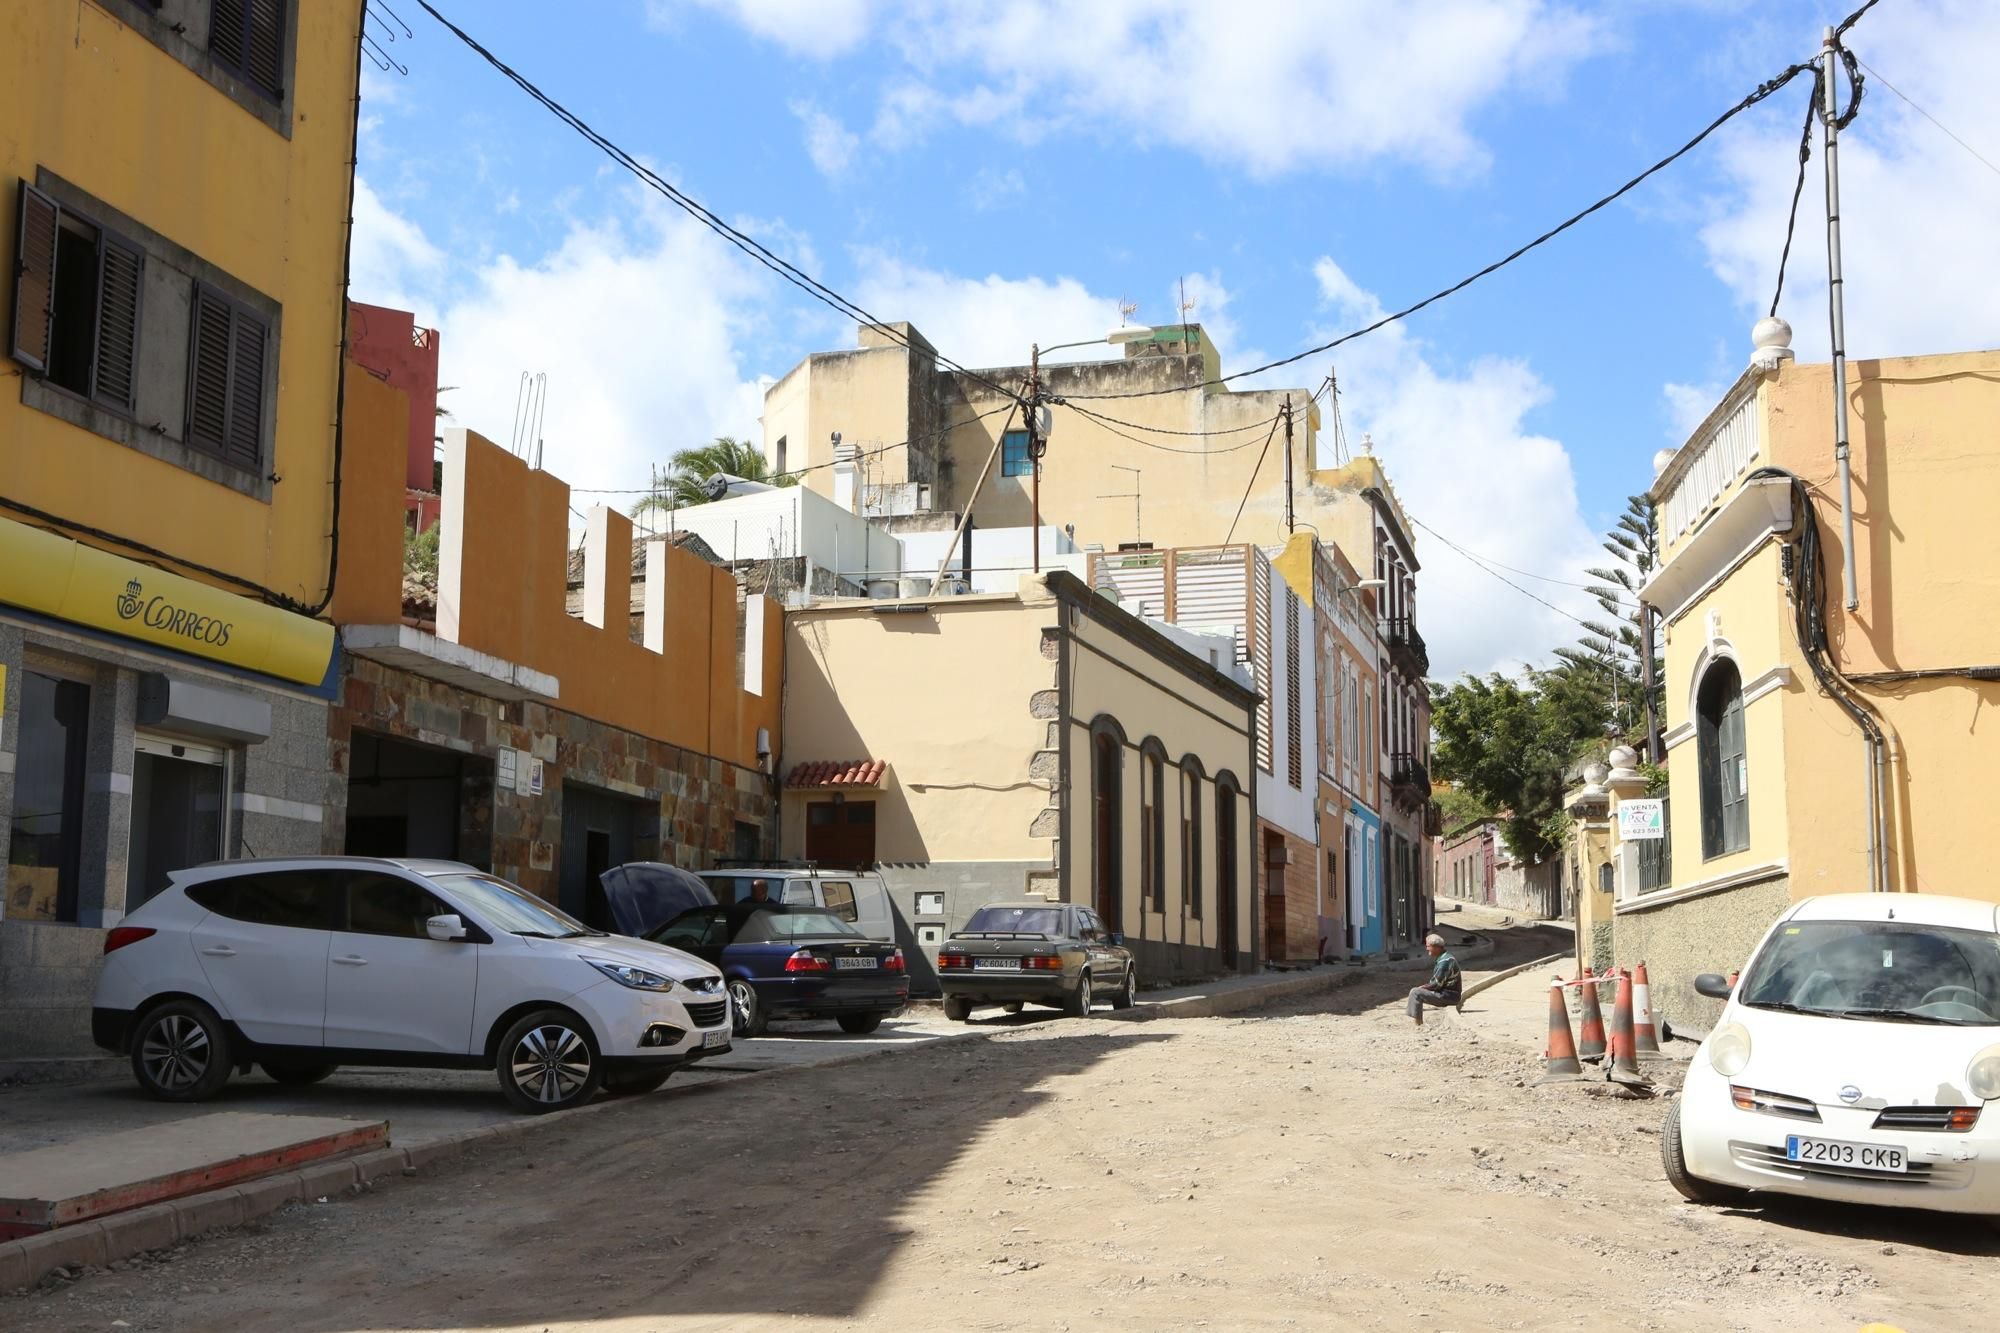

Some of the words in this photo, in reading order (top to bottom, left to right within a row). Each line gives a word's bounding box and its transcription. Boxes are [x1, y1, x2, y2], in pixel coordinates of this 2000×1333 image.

[144, 596, 233, 647] CORREOS
[979, 959, 989, 968] GC
[990, 959, 1008, 968] 6041
[1009, 959, 1018, 968] CF
[1802, 1141, 1854, 1163] 2203
[1861, 1148, 1901, 1168] CKB
